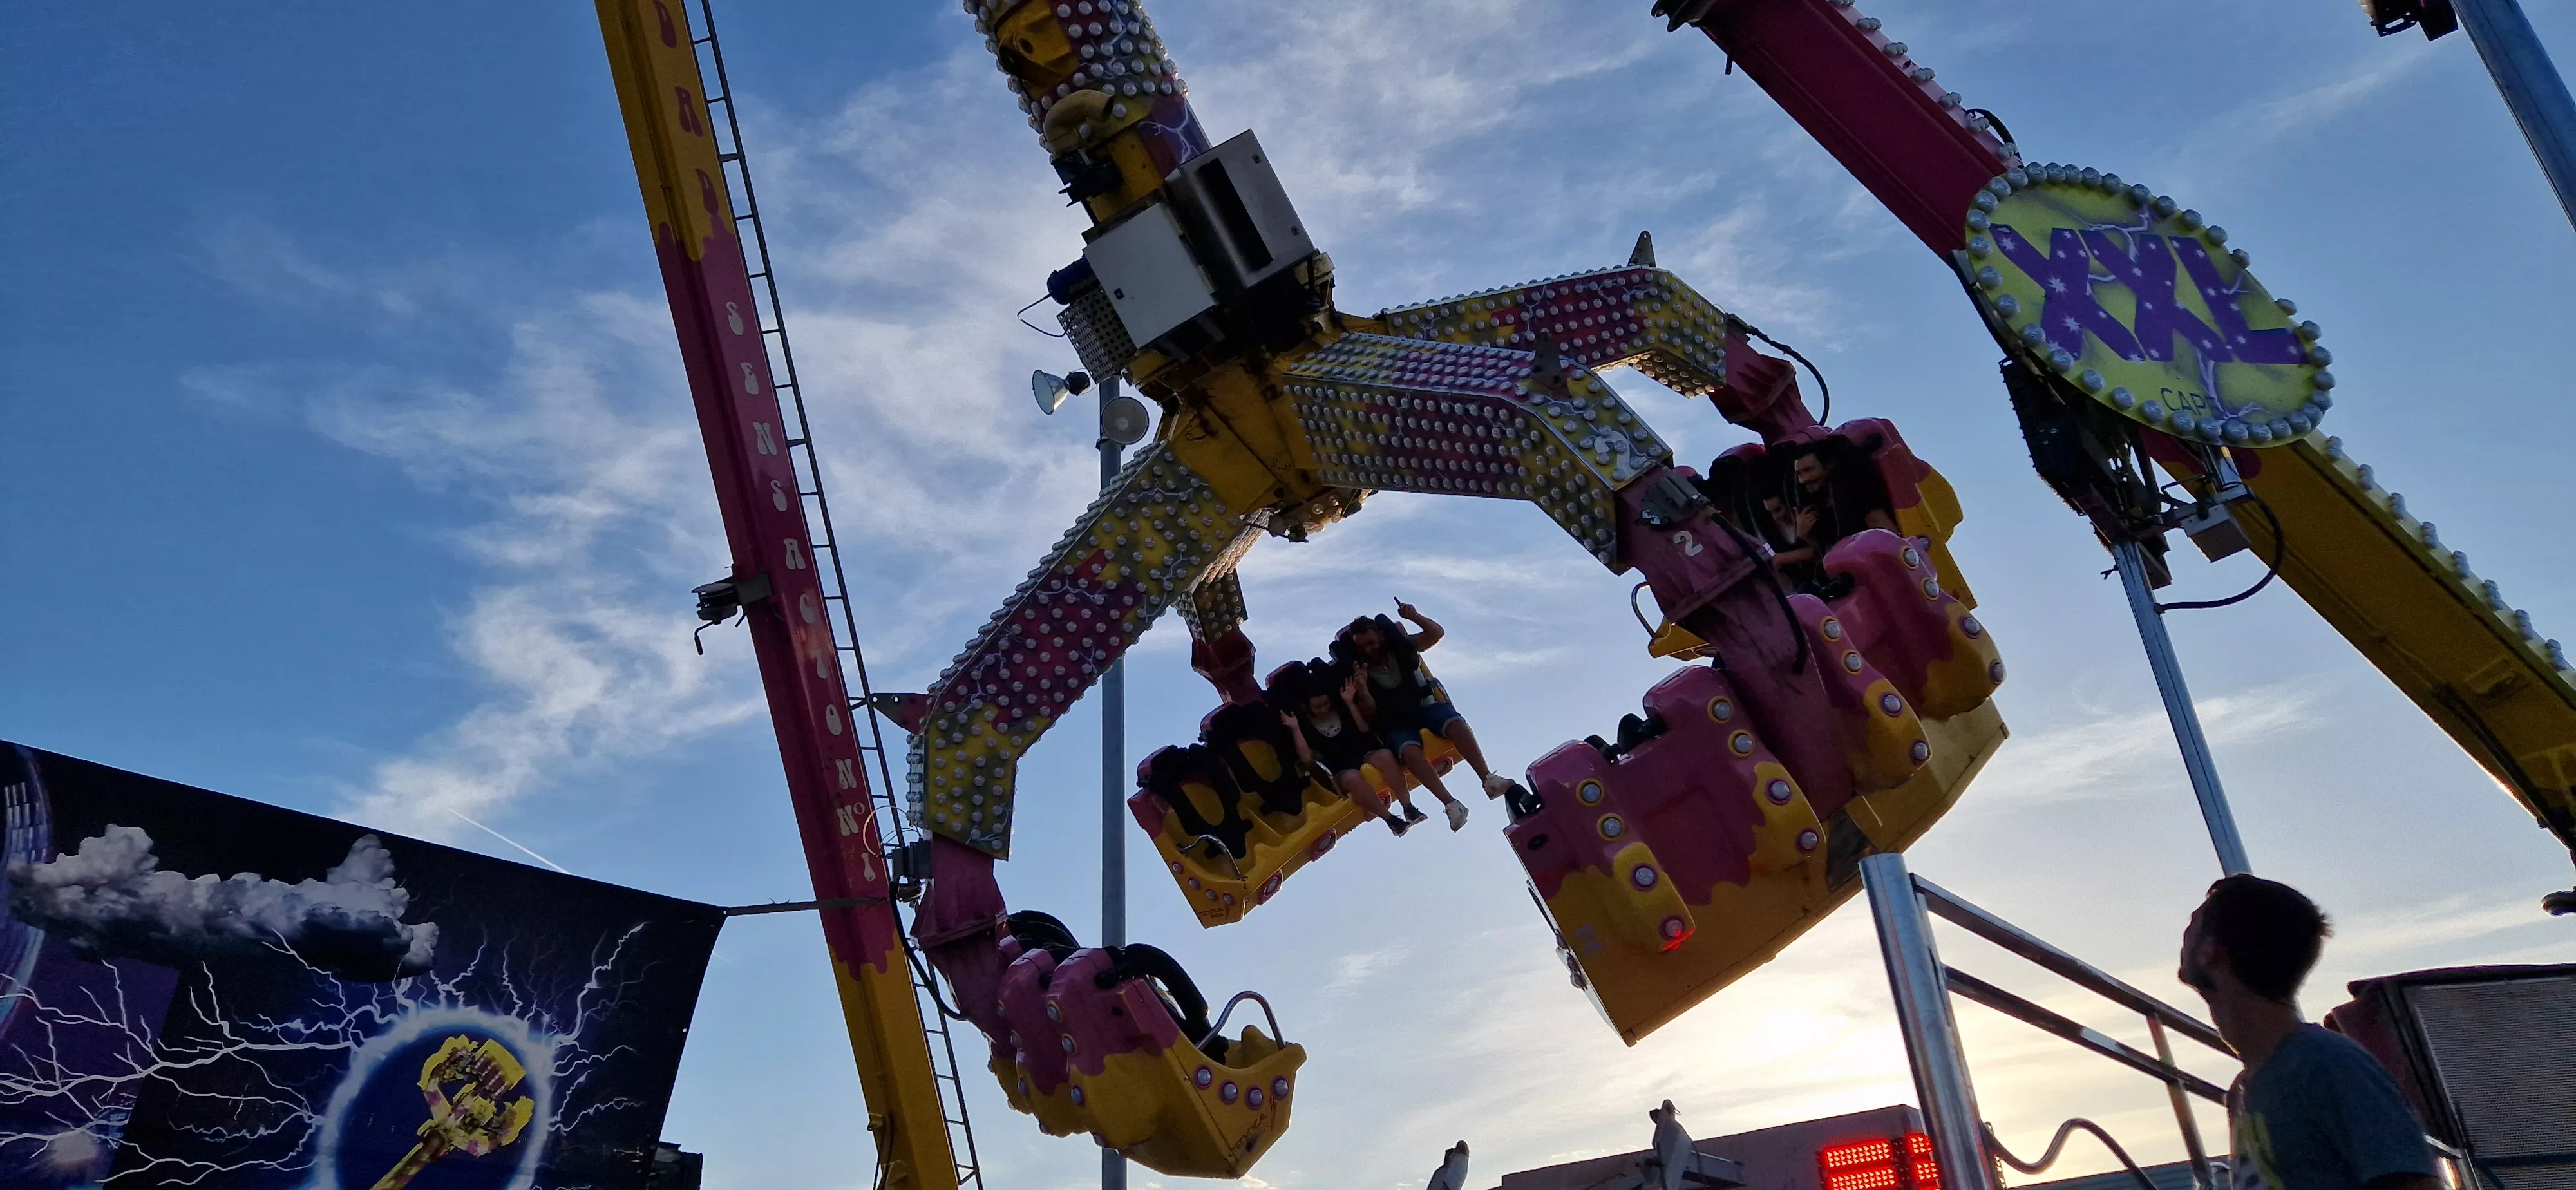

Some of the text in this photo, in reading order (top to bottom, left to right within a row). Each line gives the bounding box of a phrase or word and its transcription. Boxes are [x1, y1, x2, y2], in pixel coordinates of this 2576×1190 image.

[1989, 223, 2309, 364] XXL
[1673, 530, 1704, 557] 2
[1575, 923, 1602, 956] 2
